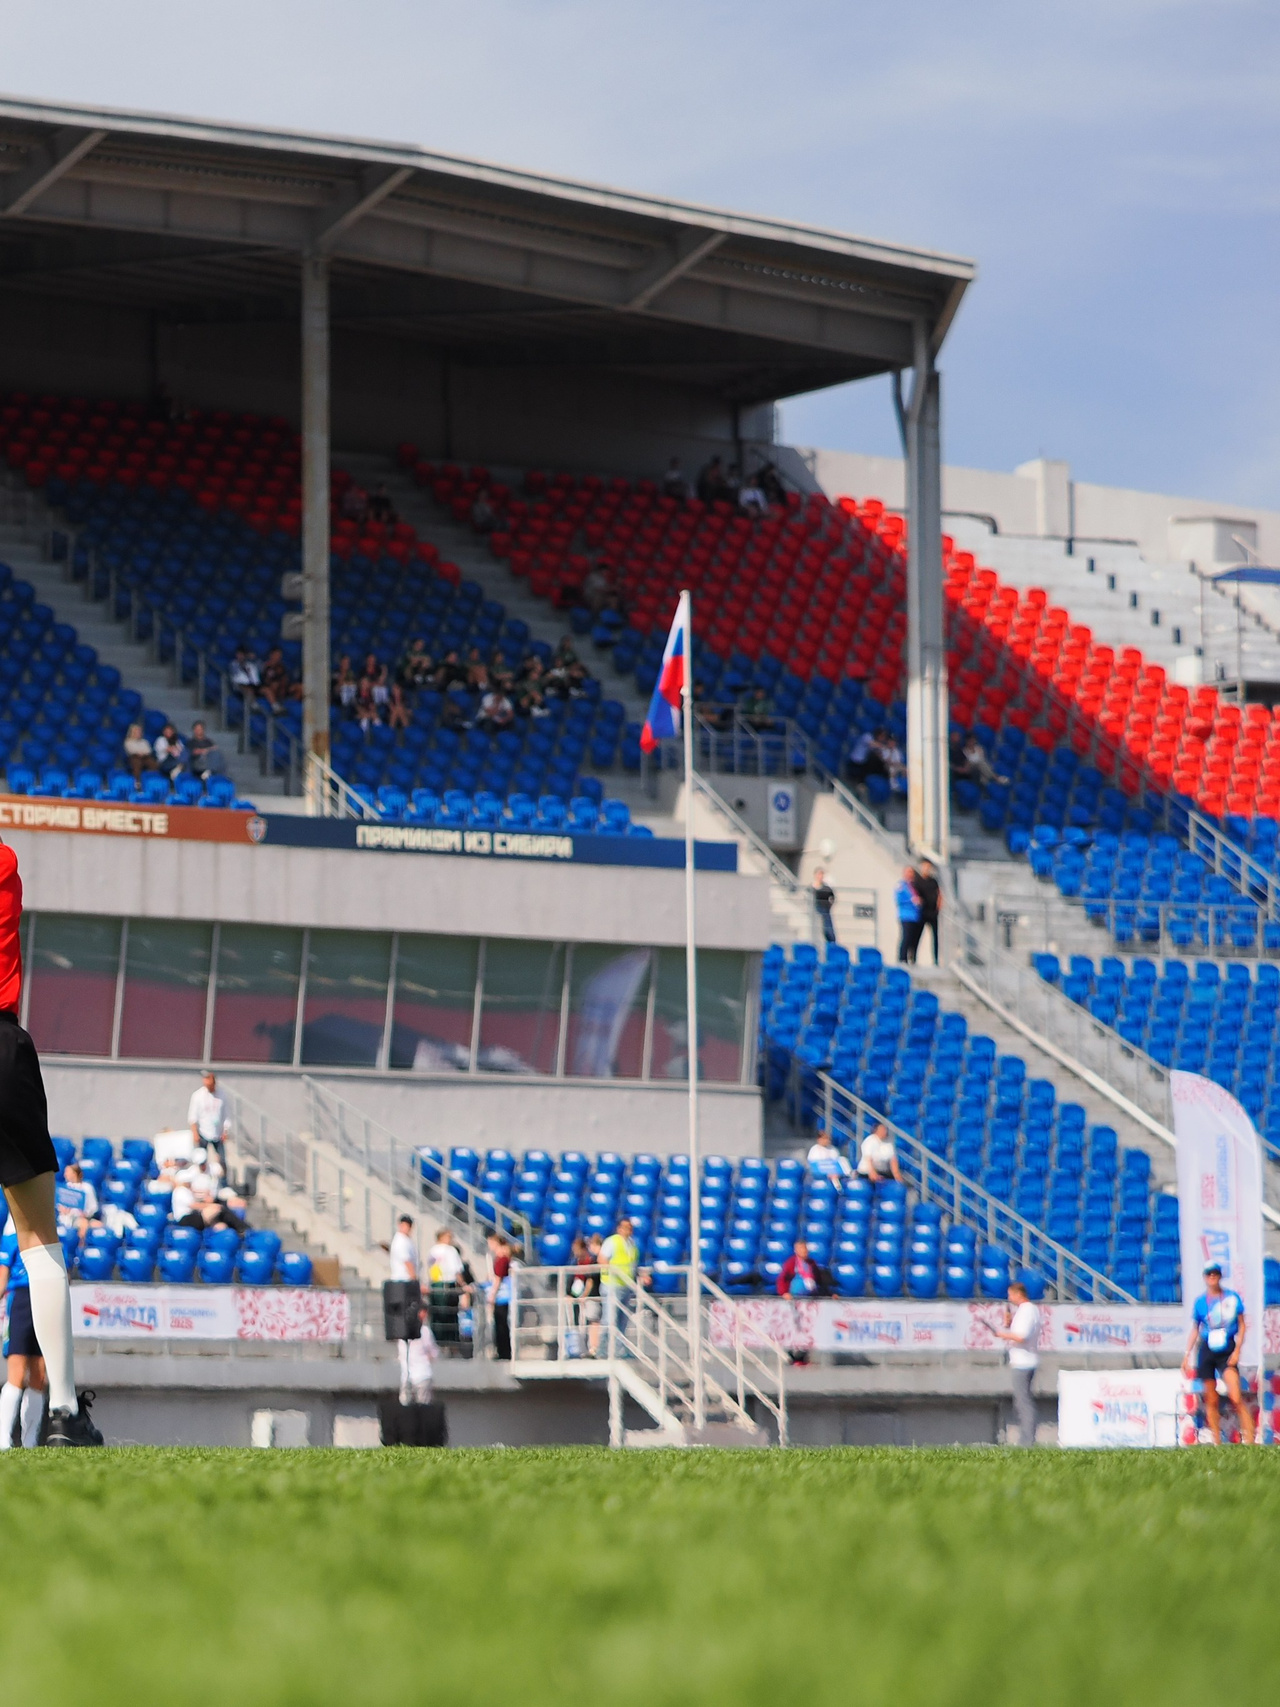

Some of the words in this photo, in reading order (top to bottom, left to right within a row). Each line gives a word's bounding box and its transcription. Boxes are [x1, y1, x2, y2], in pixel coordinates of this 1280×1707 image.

[81, 807, 169, 834] ВМЕСТЕ
[356, 824, 463, 852] ПРЯМИКОМ
[464, 830, 492, 854] ИЗ
[493, 832, 574, 859] СИБИРИ
